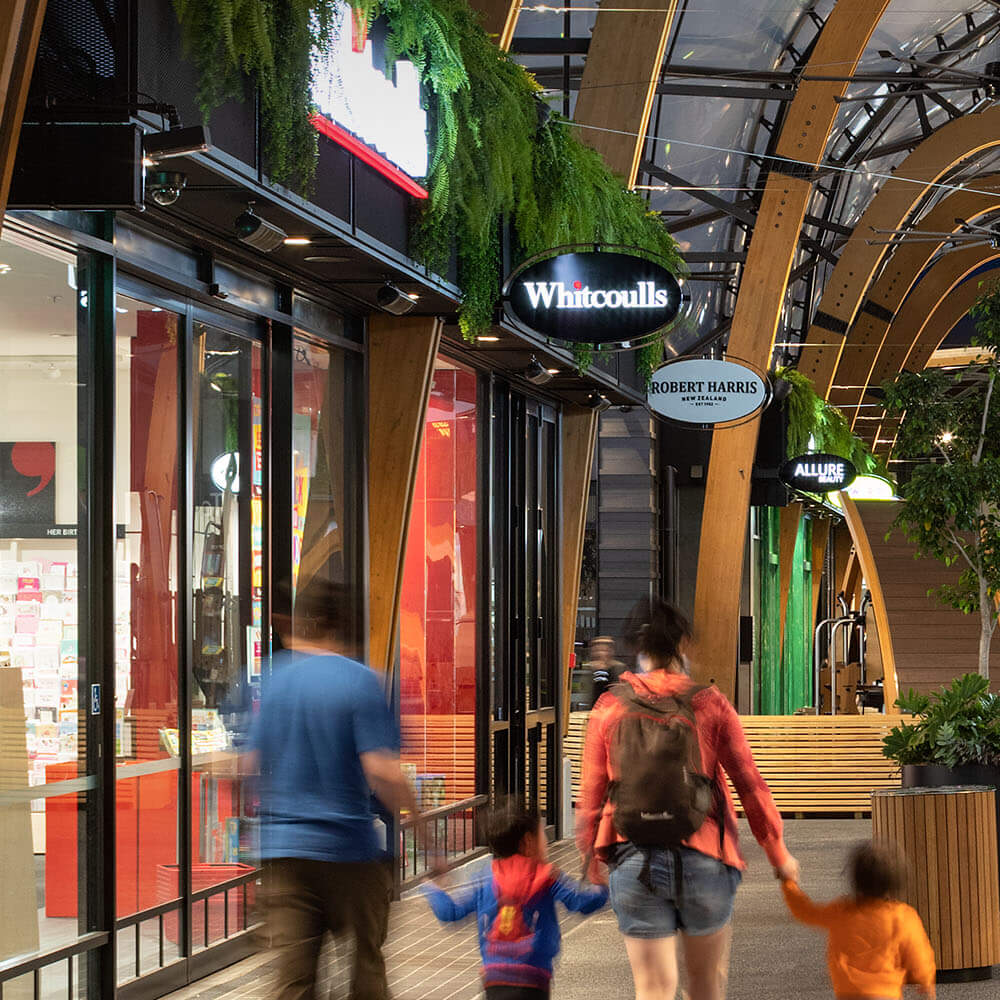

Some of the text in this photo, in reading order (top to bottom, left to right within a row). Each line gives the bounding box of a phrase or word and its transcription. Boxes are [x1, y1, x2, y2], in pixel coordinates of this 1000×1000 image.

[524, 280, 668, 309] Whitcoulls
[652, 381, 758, 394] ROBERT HARRIS
[794, 463, 845, 477] ALLURE
[46, 528, 61, 536] HER
